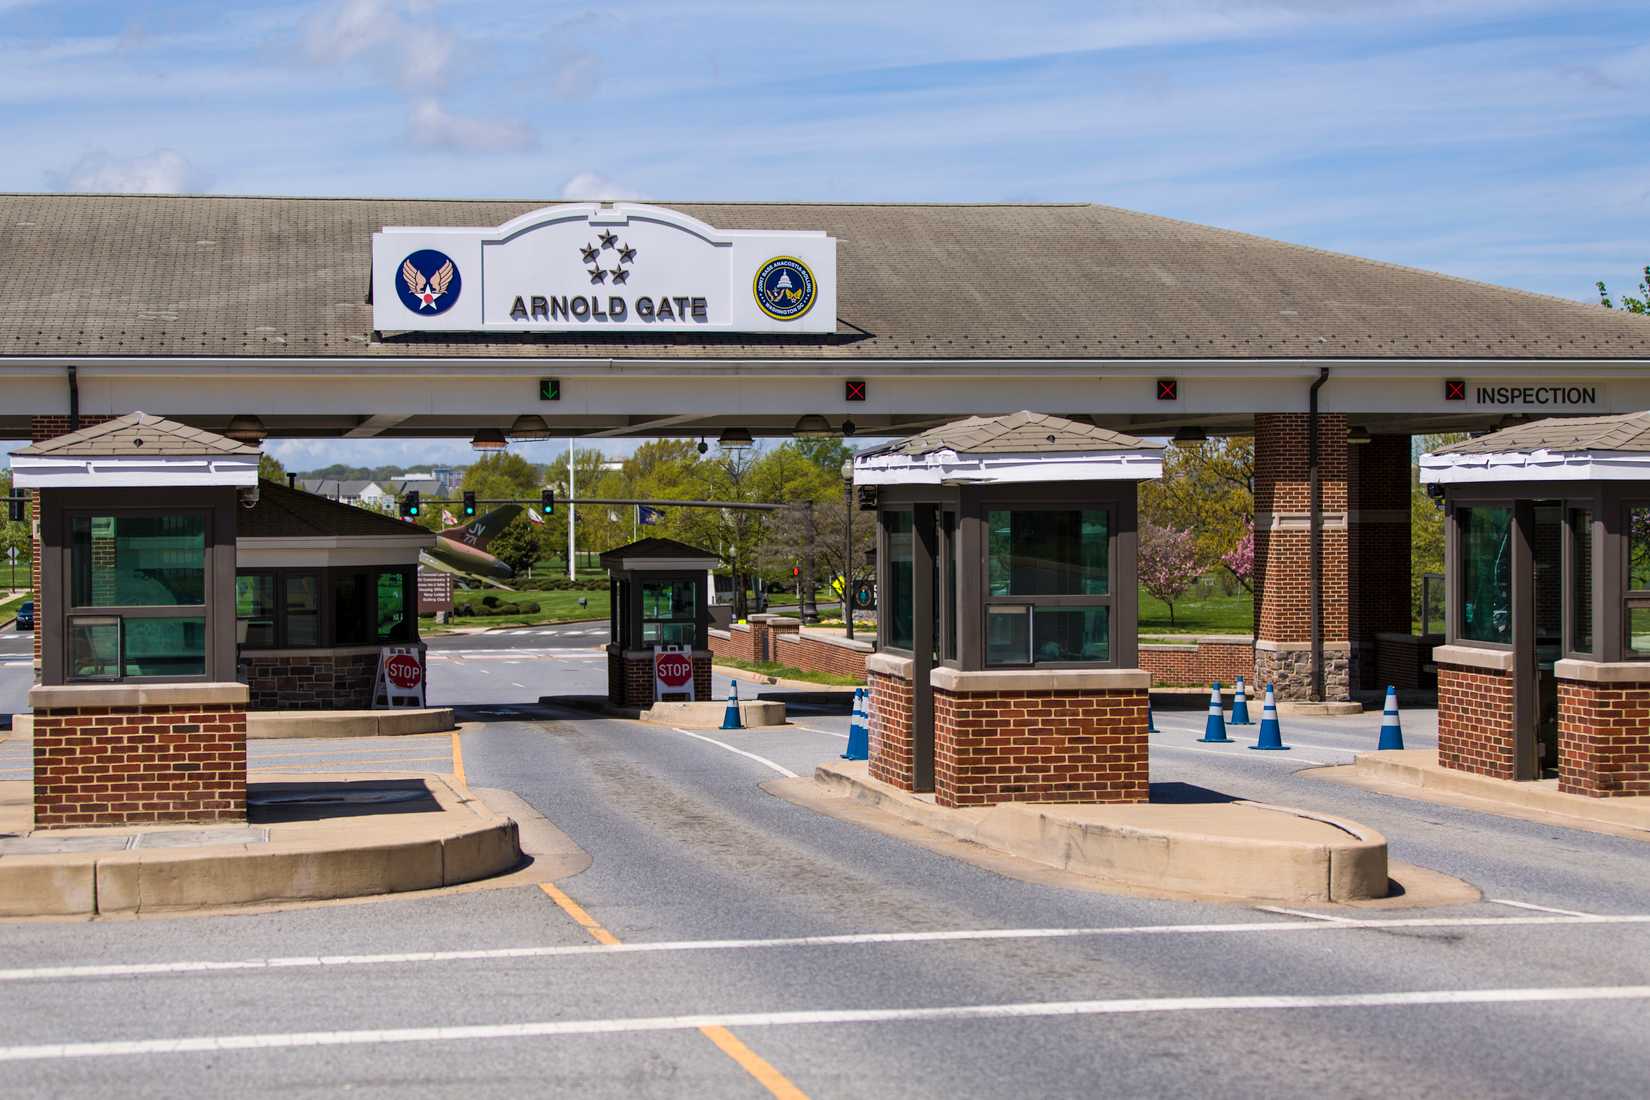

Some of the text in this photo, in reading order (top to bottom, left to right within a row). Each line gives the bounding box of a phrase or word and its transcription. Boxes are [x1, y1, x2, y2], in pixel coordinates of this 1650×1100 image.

[762, 265, 774, 277] BASE
[510, 295, 709, 320] ARNOLD GATE
[1476, 387, 1596, 404] INSPECTION
[390, 663, 420, 680] STOP
[658, 663, 690, 677] STOP
